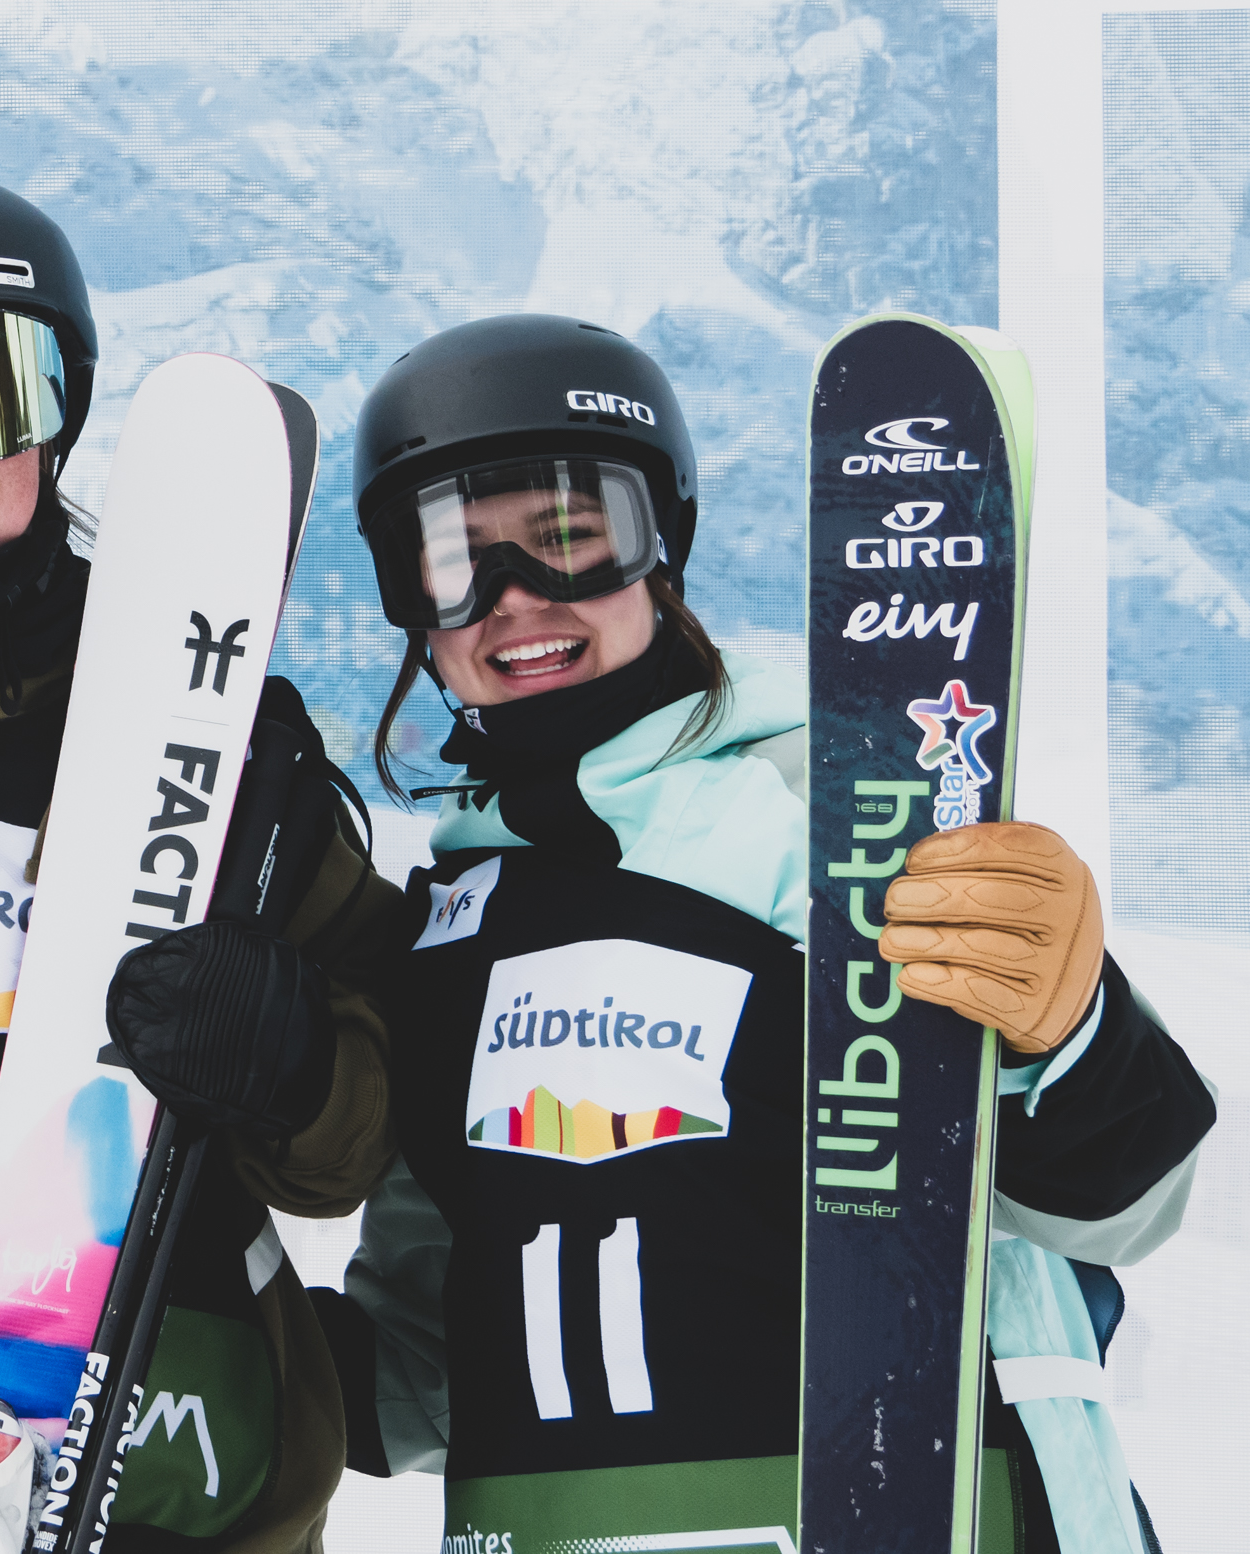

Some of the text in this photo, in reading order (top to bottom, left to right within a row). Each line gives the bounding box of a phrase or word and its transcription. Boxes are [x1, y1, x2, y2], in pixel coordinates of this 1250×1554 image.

[566, 390, 655, 425] GIRO
[842, 451, 980, 475] O'NEILL
[846, 536, 985, 569] GIRO
[855, 803, 893, 813] 168
[934, 759, 964, 832] Star
[815, 1195, 901, 1218] transfer
[522, 1217, 653, 1420] 11
[40, 1352, 109, 1527] FACTION
